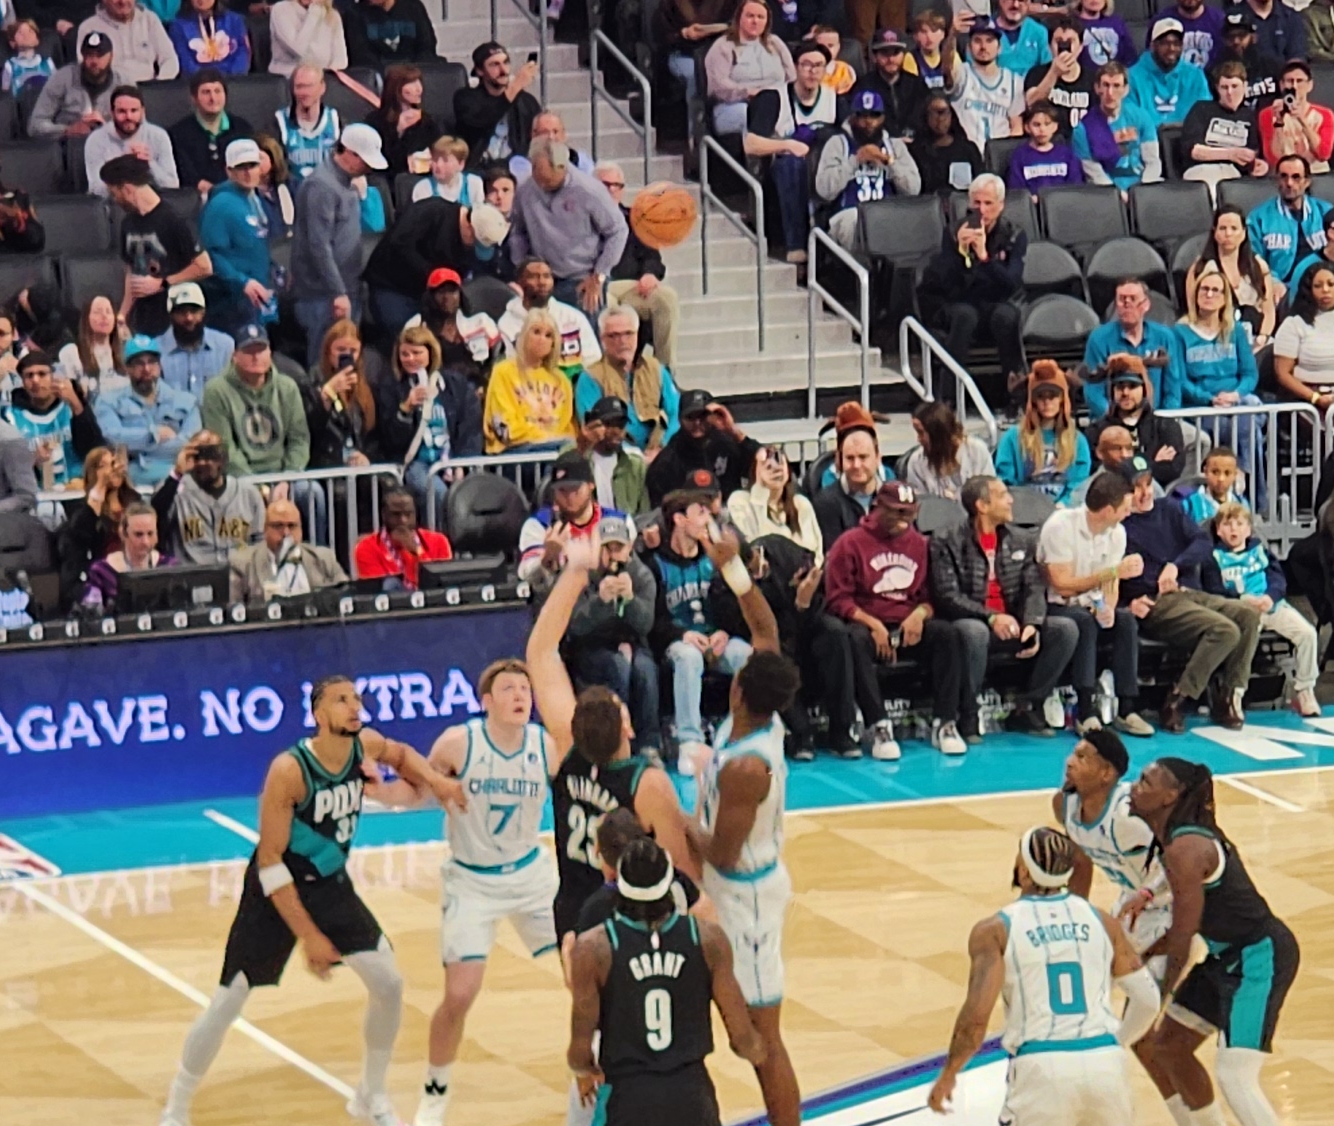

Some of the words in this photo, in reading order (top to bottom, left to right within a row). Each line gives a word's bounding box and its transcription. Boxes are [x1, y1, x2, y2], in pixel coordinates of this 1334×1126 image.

[200, 687, 284, 738] NO
[303, 668, 484, 727] XTRA
[313, 778, 364, 823] PDX
[468, 777, 541, 798] CHARLOTTE
[489, 803, 519, 836] 7
[1026, 922, 1090, 948] BRIDGES
[629, 951, 686, 981] GRANT
[1046, 961, 1088, 1015] 0
[644, 988, 672, 1051] 9
